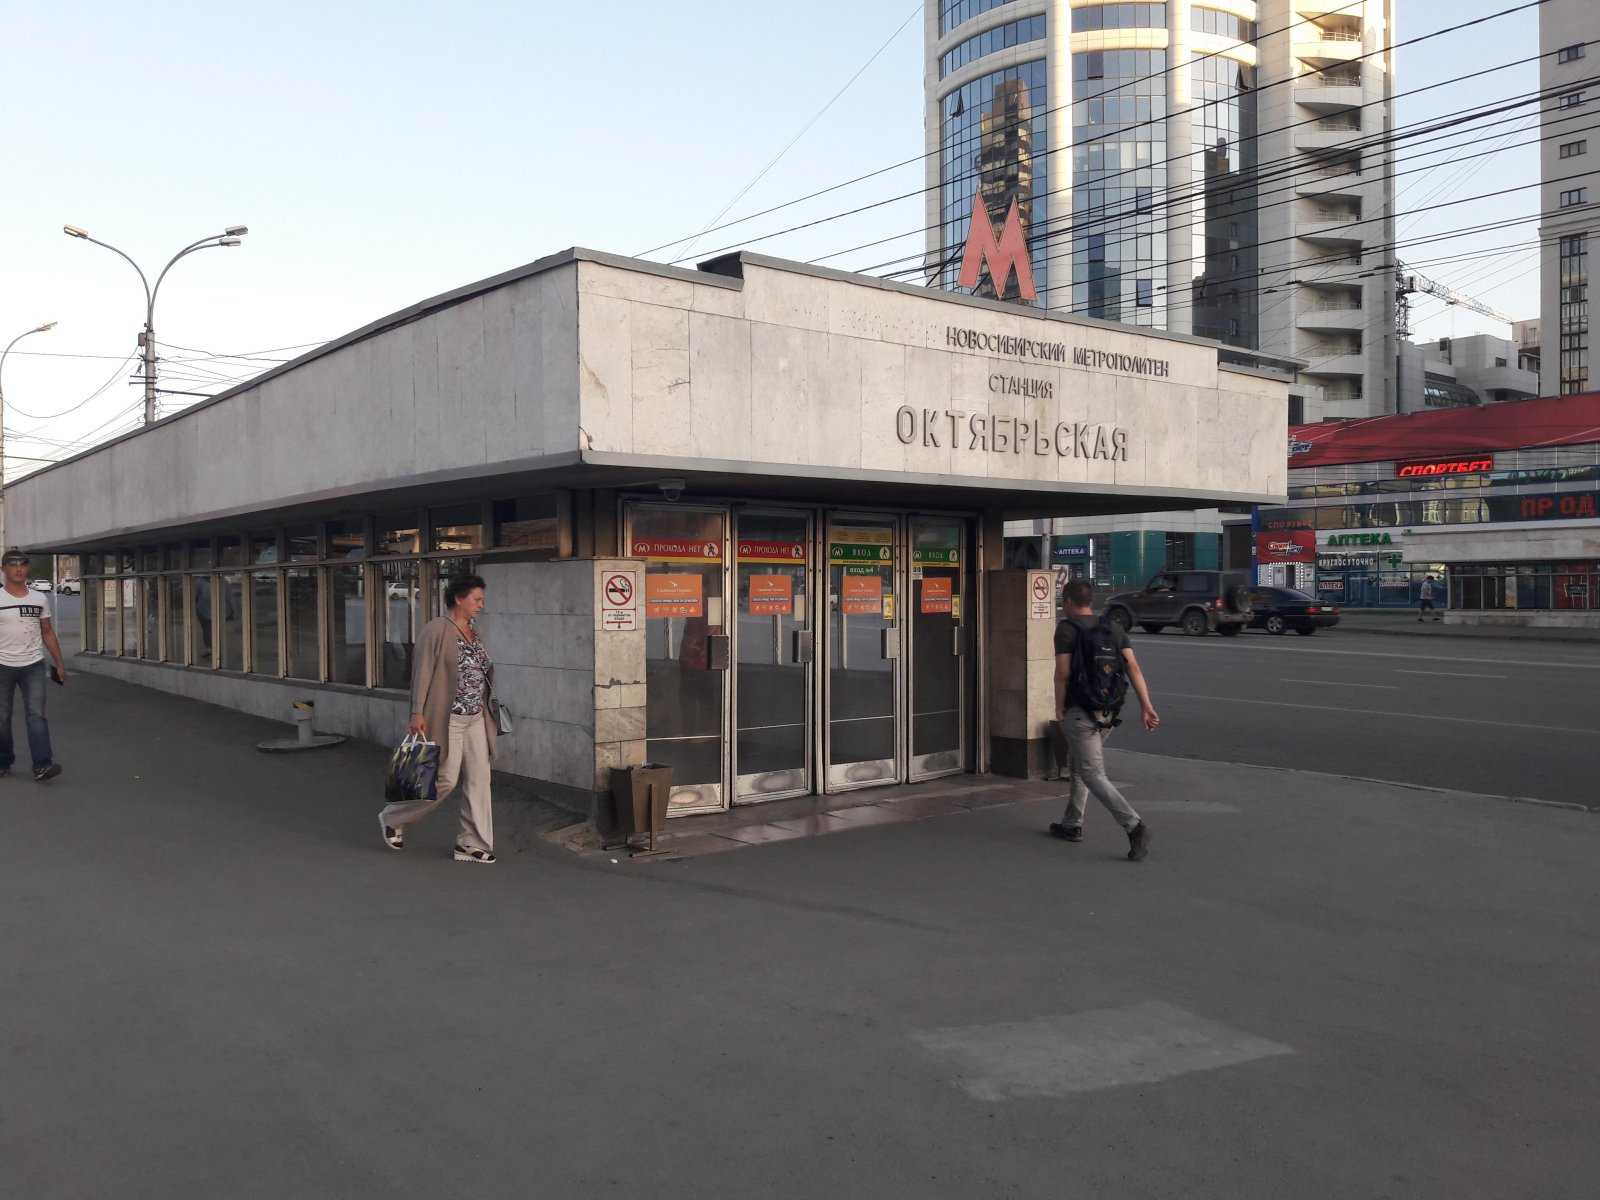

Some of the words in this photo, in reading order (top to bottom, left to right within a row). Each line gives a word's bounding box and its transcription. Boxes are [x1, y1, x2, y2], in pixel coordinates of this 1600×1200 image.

[956, 187, 1037, 301] М
[945, 326, 1066, 363] НОВОСИБИРСКИЙ
[1073, 346, 1170, 378] МЕТРОПОЛИТЕН
[988, 375, 1053, 399] СТАНЦИЯ
[896, 404, 1129, 462] ОКТЯБРЬСКАЯ
[1327, 532, 1393, 546] АПТЕКА
[1318, 557, 1375, 567] КРУГЛОСУТОЧНО
